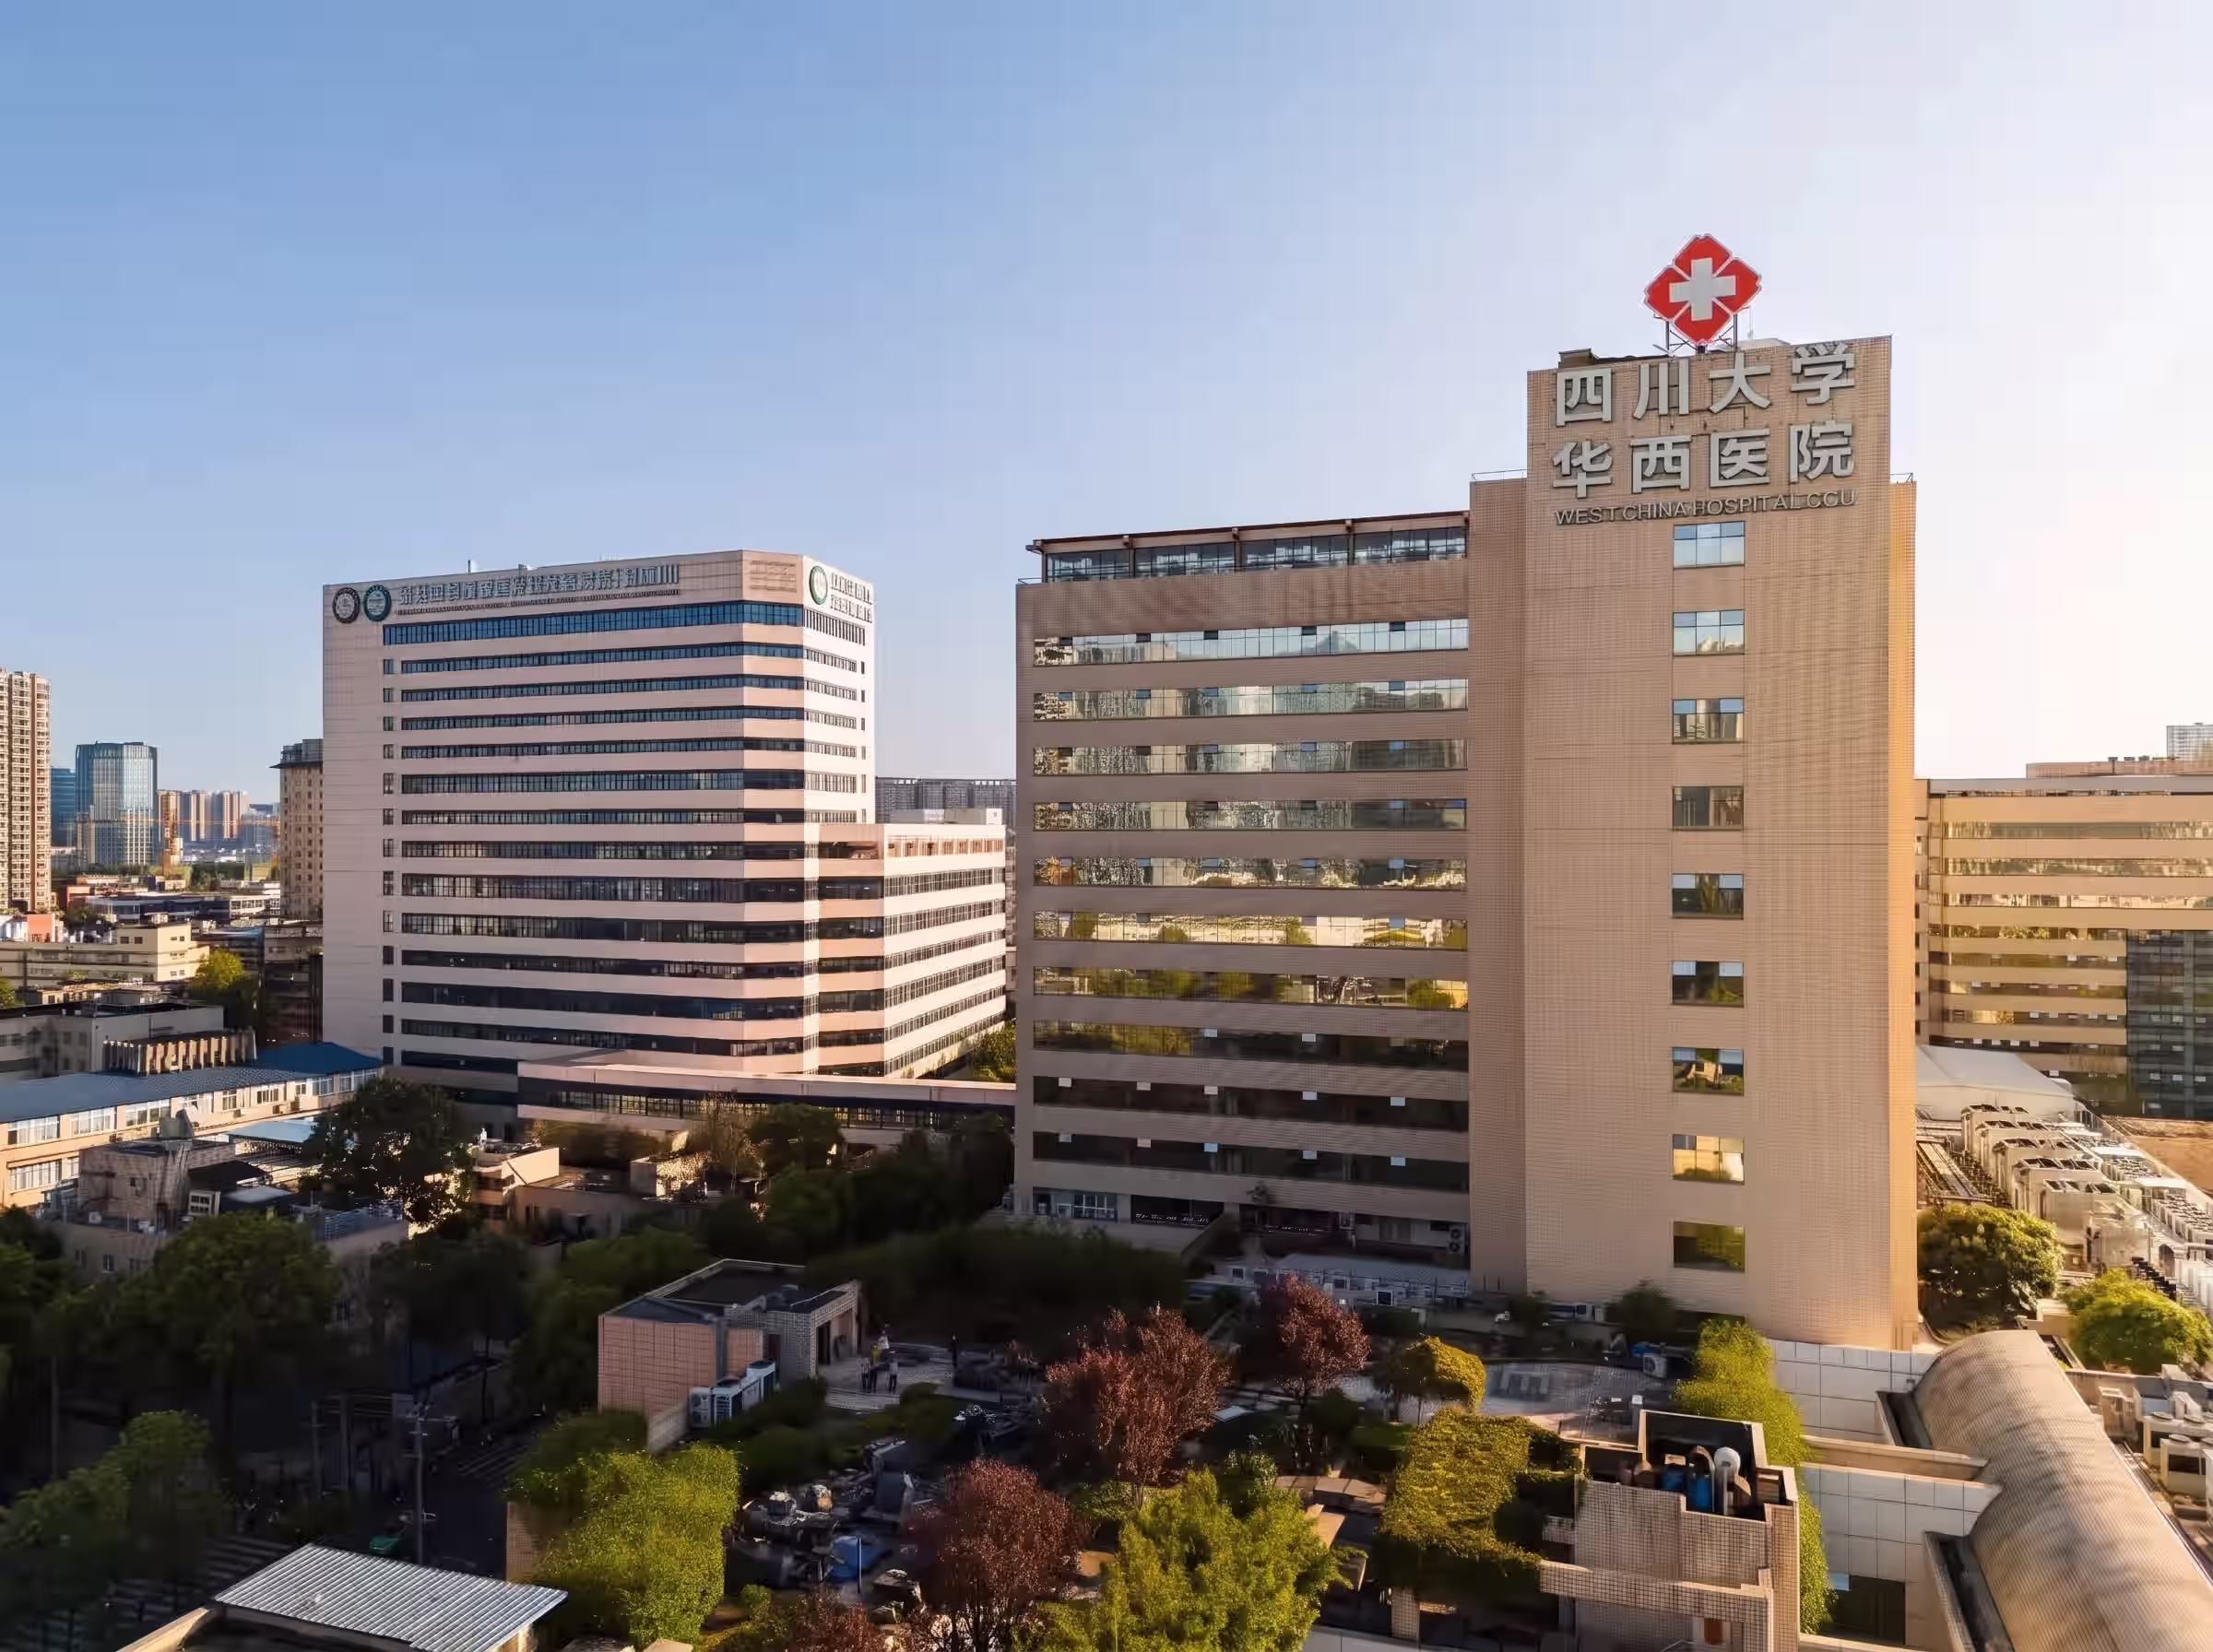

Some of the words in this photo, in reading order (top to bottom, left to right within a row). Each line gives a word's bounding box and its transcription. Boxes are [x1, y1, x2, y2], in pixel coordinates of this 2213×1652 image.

[1556, 343, 1856, 426] 四川大学
[1553, 420, 1854, 499] 华西医院
[1556, 507, 1619, 525] WEST
[1623, 502, 1686, 521] CHINA
[1693, 494, 1800, 515] HOSPITAL
